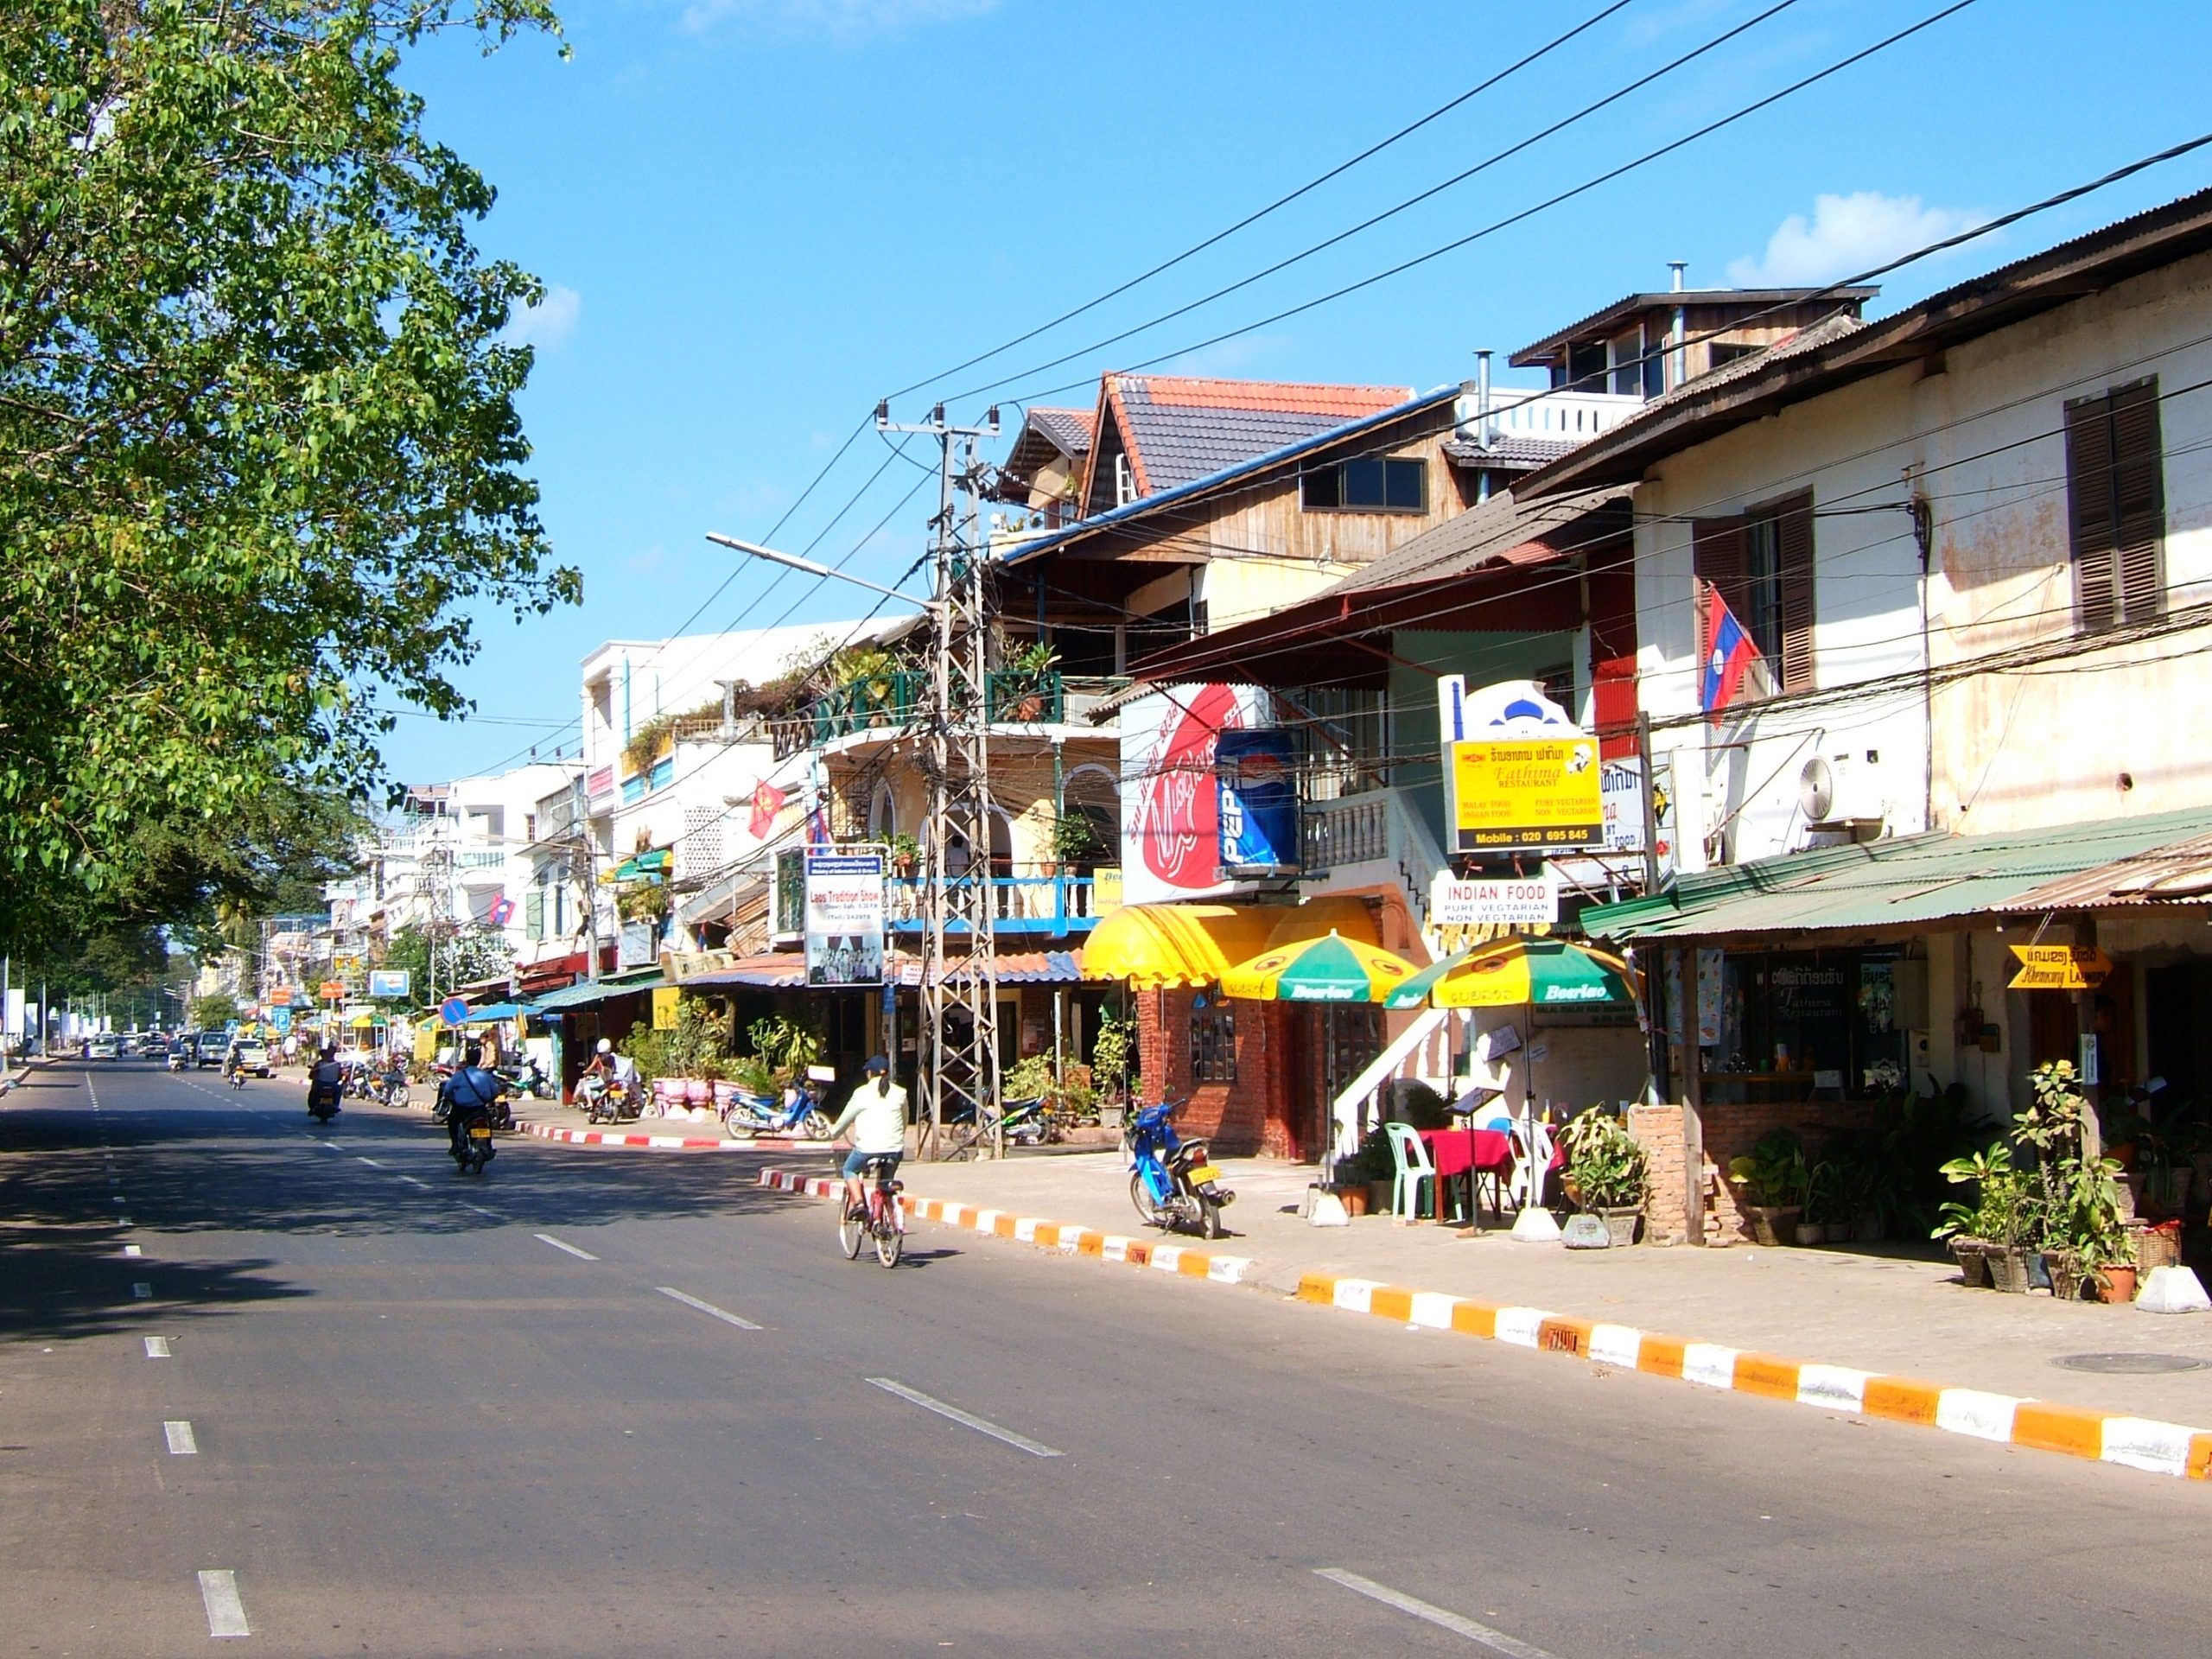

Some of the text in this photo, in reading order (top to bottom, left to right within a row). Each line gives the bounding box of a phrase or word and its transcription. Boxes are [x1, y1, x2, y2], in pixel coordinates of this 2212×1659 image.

[1494, 764, 1561, 780] Fathima
[1498, 779, 1558, 788] RESTAURANT
[1522, 832, 1541, 842] 020
[1546, 830, 1567, 841] 695
[1568, 830, 1588, 839] 845
[1615, 835, 1637, 848] FOOD
[1447, 885, 1546, 900] INDIAN FOOD
[1477, 913, 1545, 922] VEGTARIAN
[1291, 984, 1354, 999] Beerlao
[1545, 983, 1606, 1001] Beerlao
